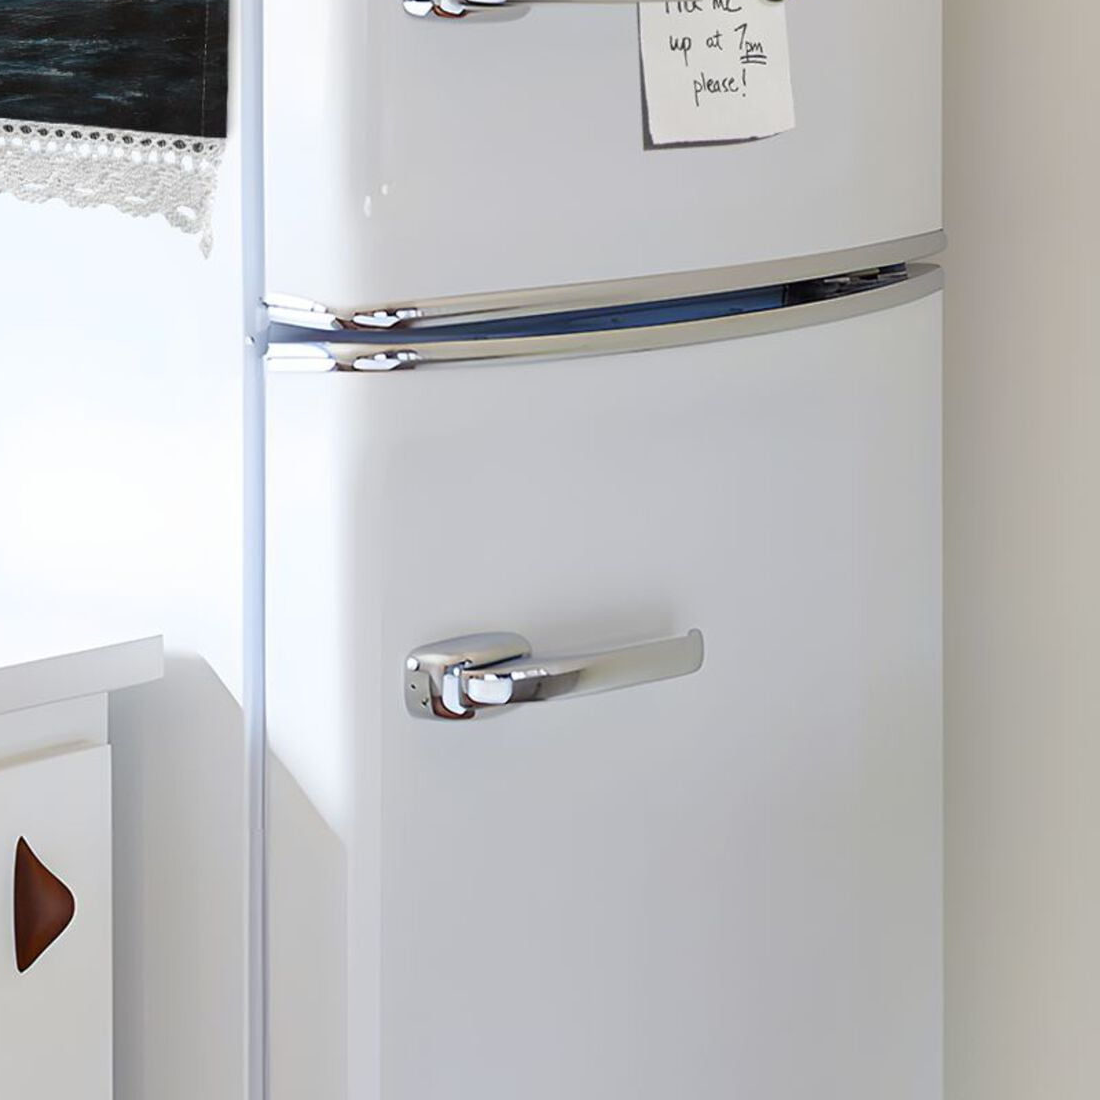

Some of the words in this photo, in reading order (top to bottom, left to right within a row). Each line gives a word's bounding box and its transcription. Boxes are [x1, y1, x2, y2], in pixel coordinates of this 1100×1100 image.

[669, 35, 692, 67] up
[706, 30, 723, 51] at
[693, 68, 747, 107] please!
